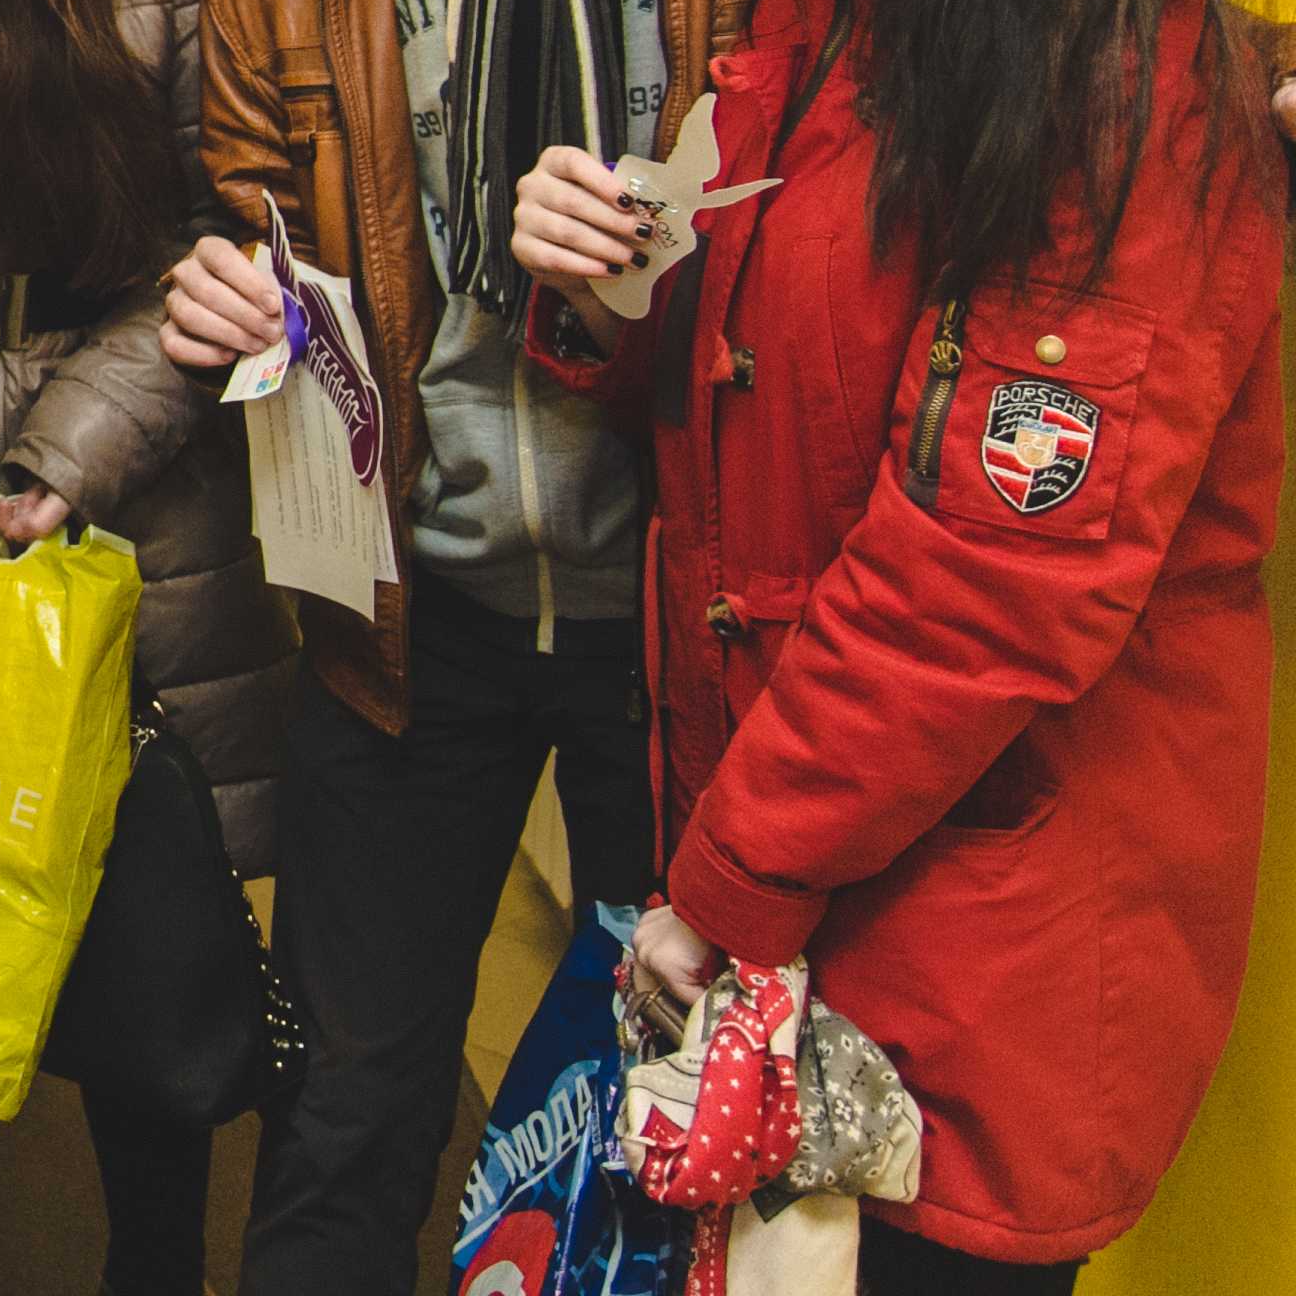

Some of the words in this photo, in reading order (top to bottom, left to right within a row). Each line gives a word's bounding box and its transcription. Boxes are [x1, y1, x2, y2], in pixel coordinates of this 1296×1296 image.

[998, 386, 1093, 422] PORSCHE
[459, 1157, 498, 1223] Я
[494, 1073, 594, 1186] МОДА
